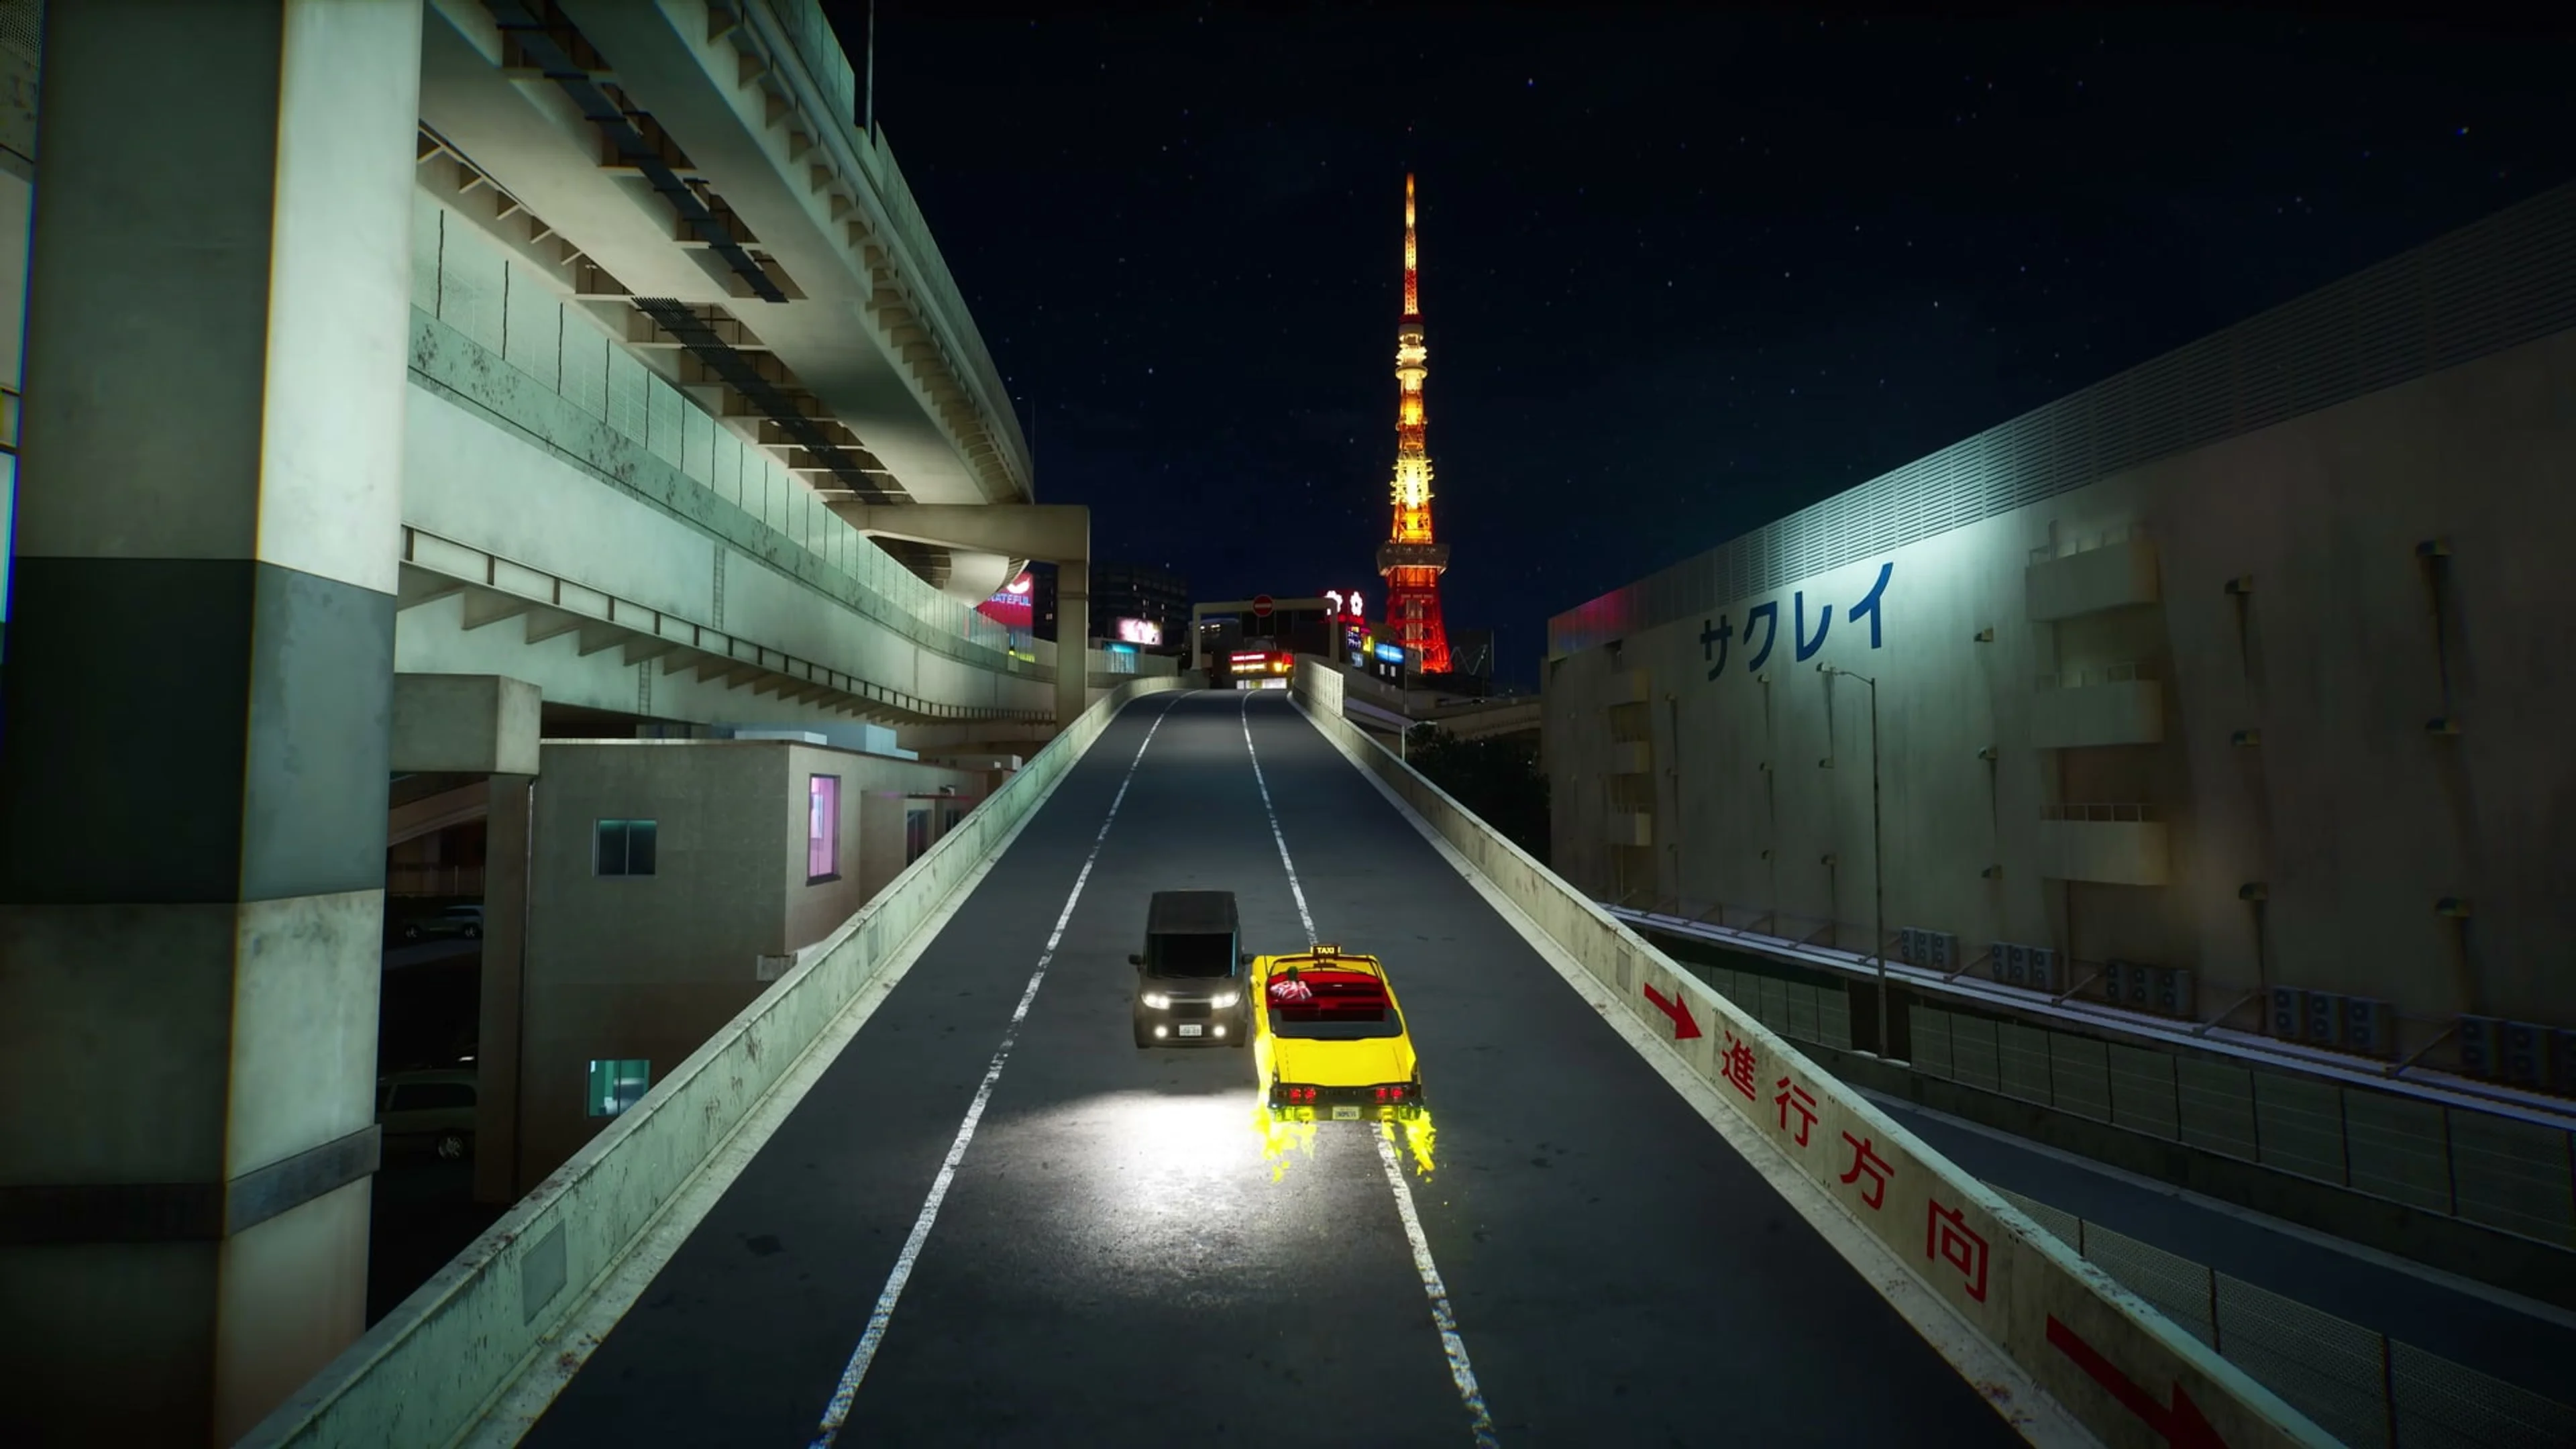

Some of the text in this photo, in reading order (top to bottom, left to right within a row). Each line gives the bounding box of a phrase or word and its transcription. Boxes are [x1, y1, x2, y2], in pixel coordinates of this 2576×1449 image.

[1700, 562, 1893, 682] サクレイ
[1721, 1031, 1988, 1303] 進行方向
